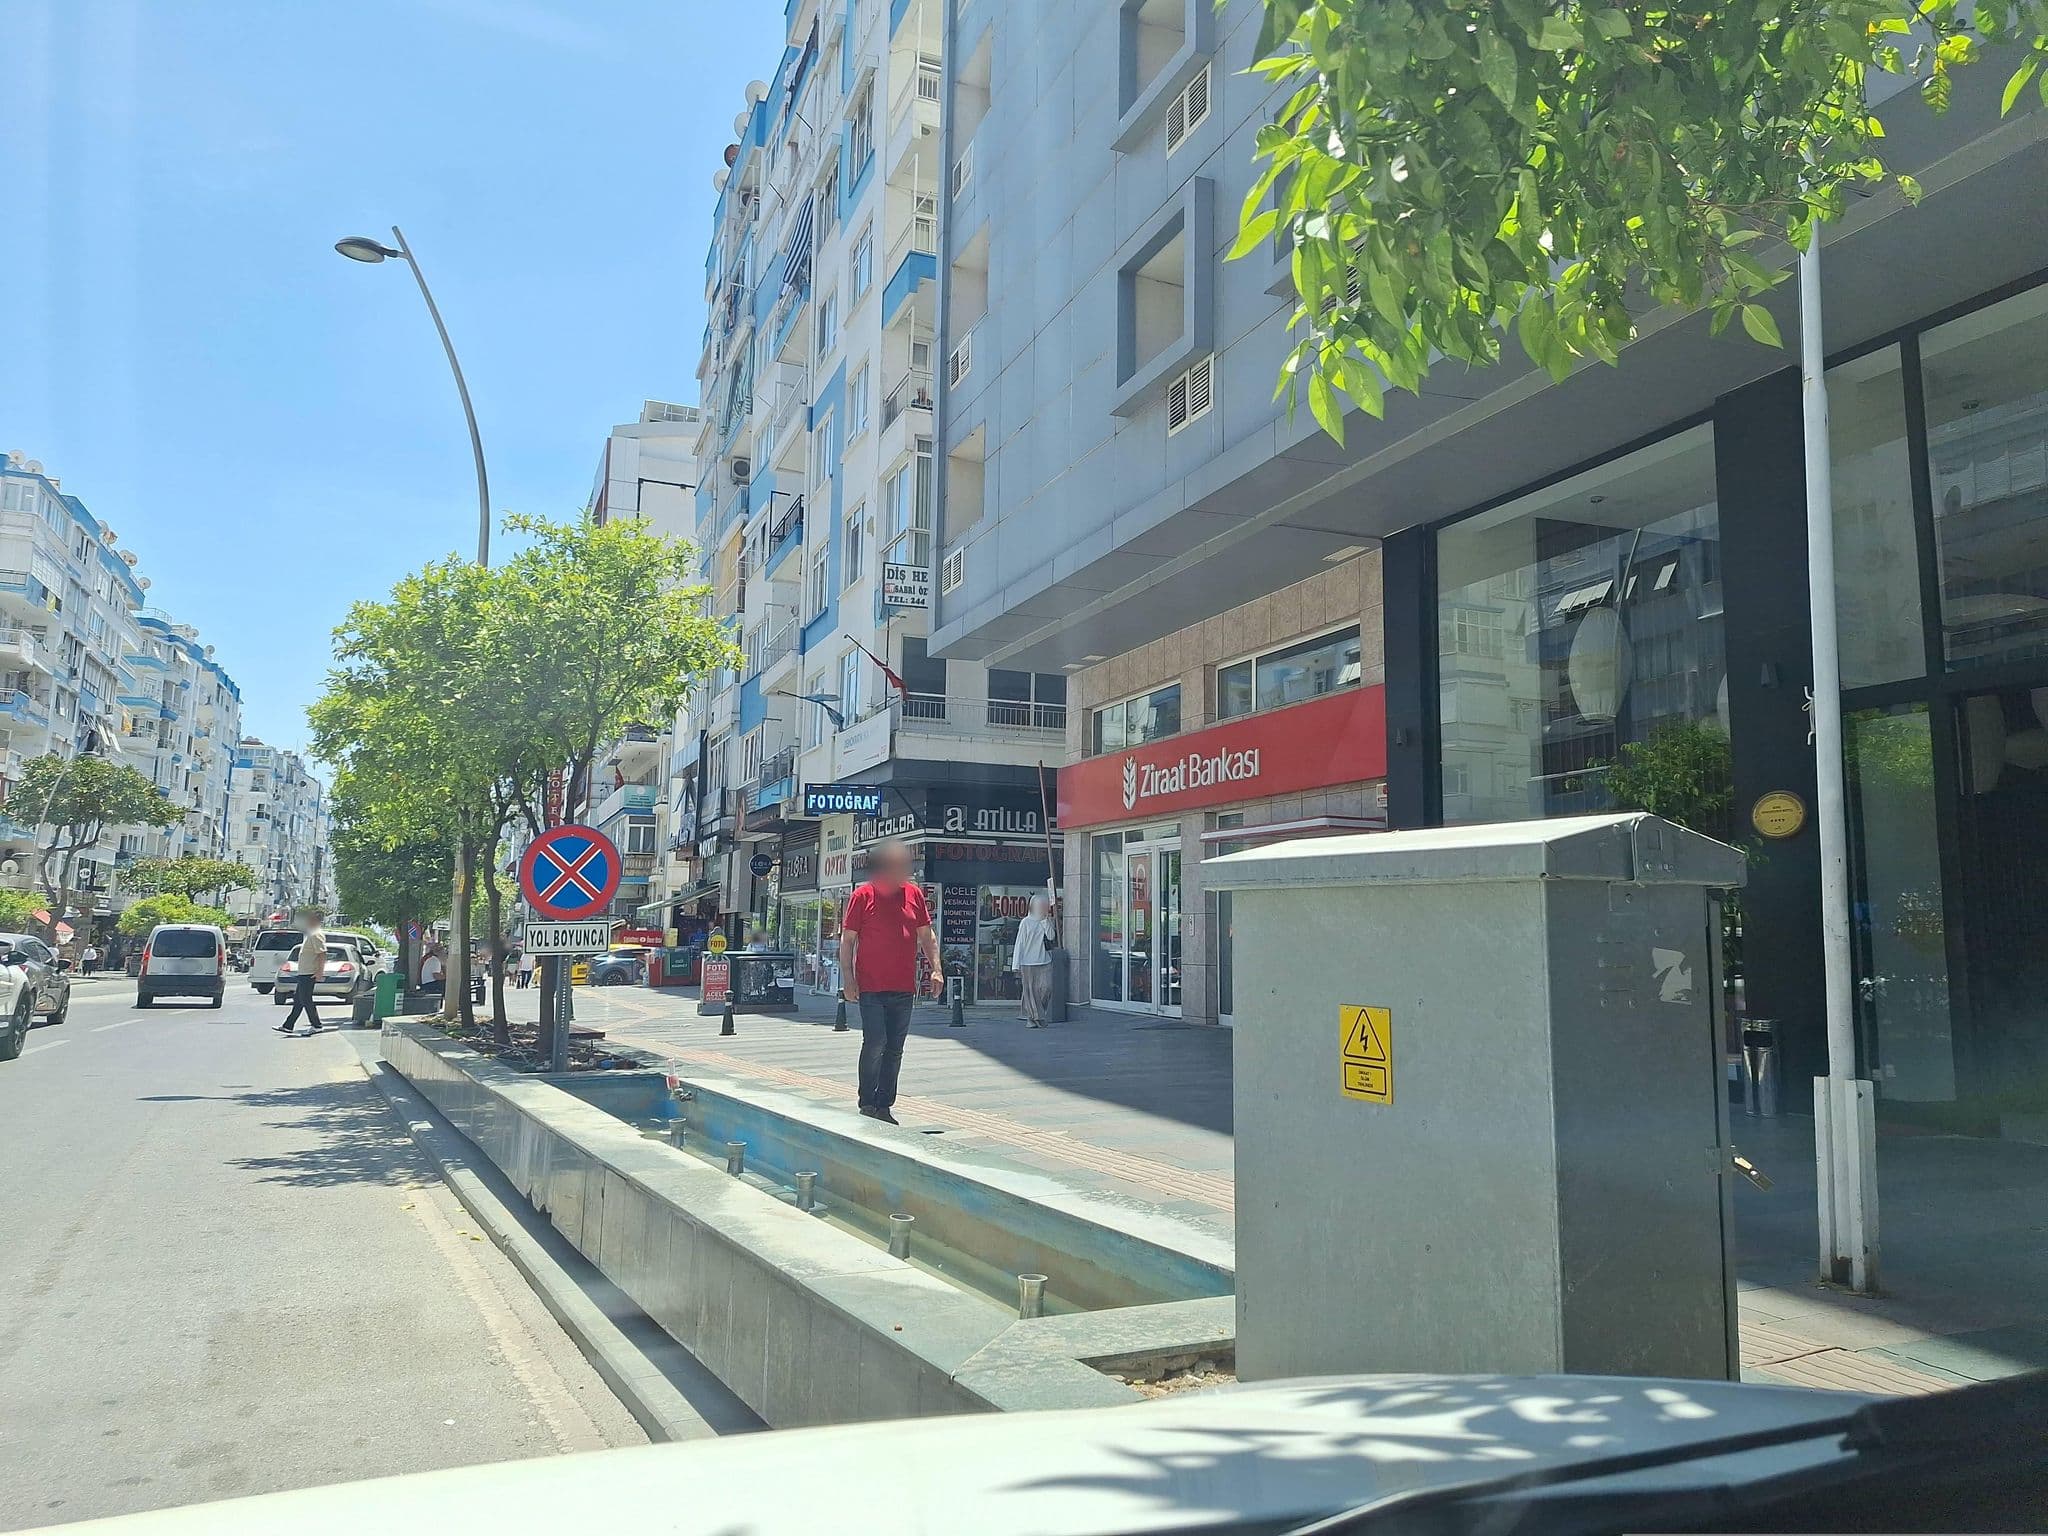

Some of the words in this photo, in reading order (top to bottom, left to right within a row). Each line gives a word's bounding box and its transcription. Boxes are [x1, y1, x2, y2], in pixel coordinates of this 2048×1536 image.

[886, 566, 906, 584] DİŞ
[888, 596, 908, 604] TEL:
[1140, 757, 1187, 798] Ziraat
[1189, 747, 1260, 788] Bankası
[808, 792, 878, 810] FOTOĞRAF
[878, 814, 915, 837] COLOR
[974, 806, 1037, 832] ATİLLA
[824, 854, 848, 876] OPTİK
[944, 887, 976, 896] ACELE
[530, 928, 550, 948] YOL
[553, 924, 604, 946] BOYUNCA
